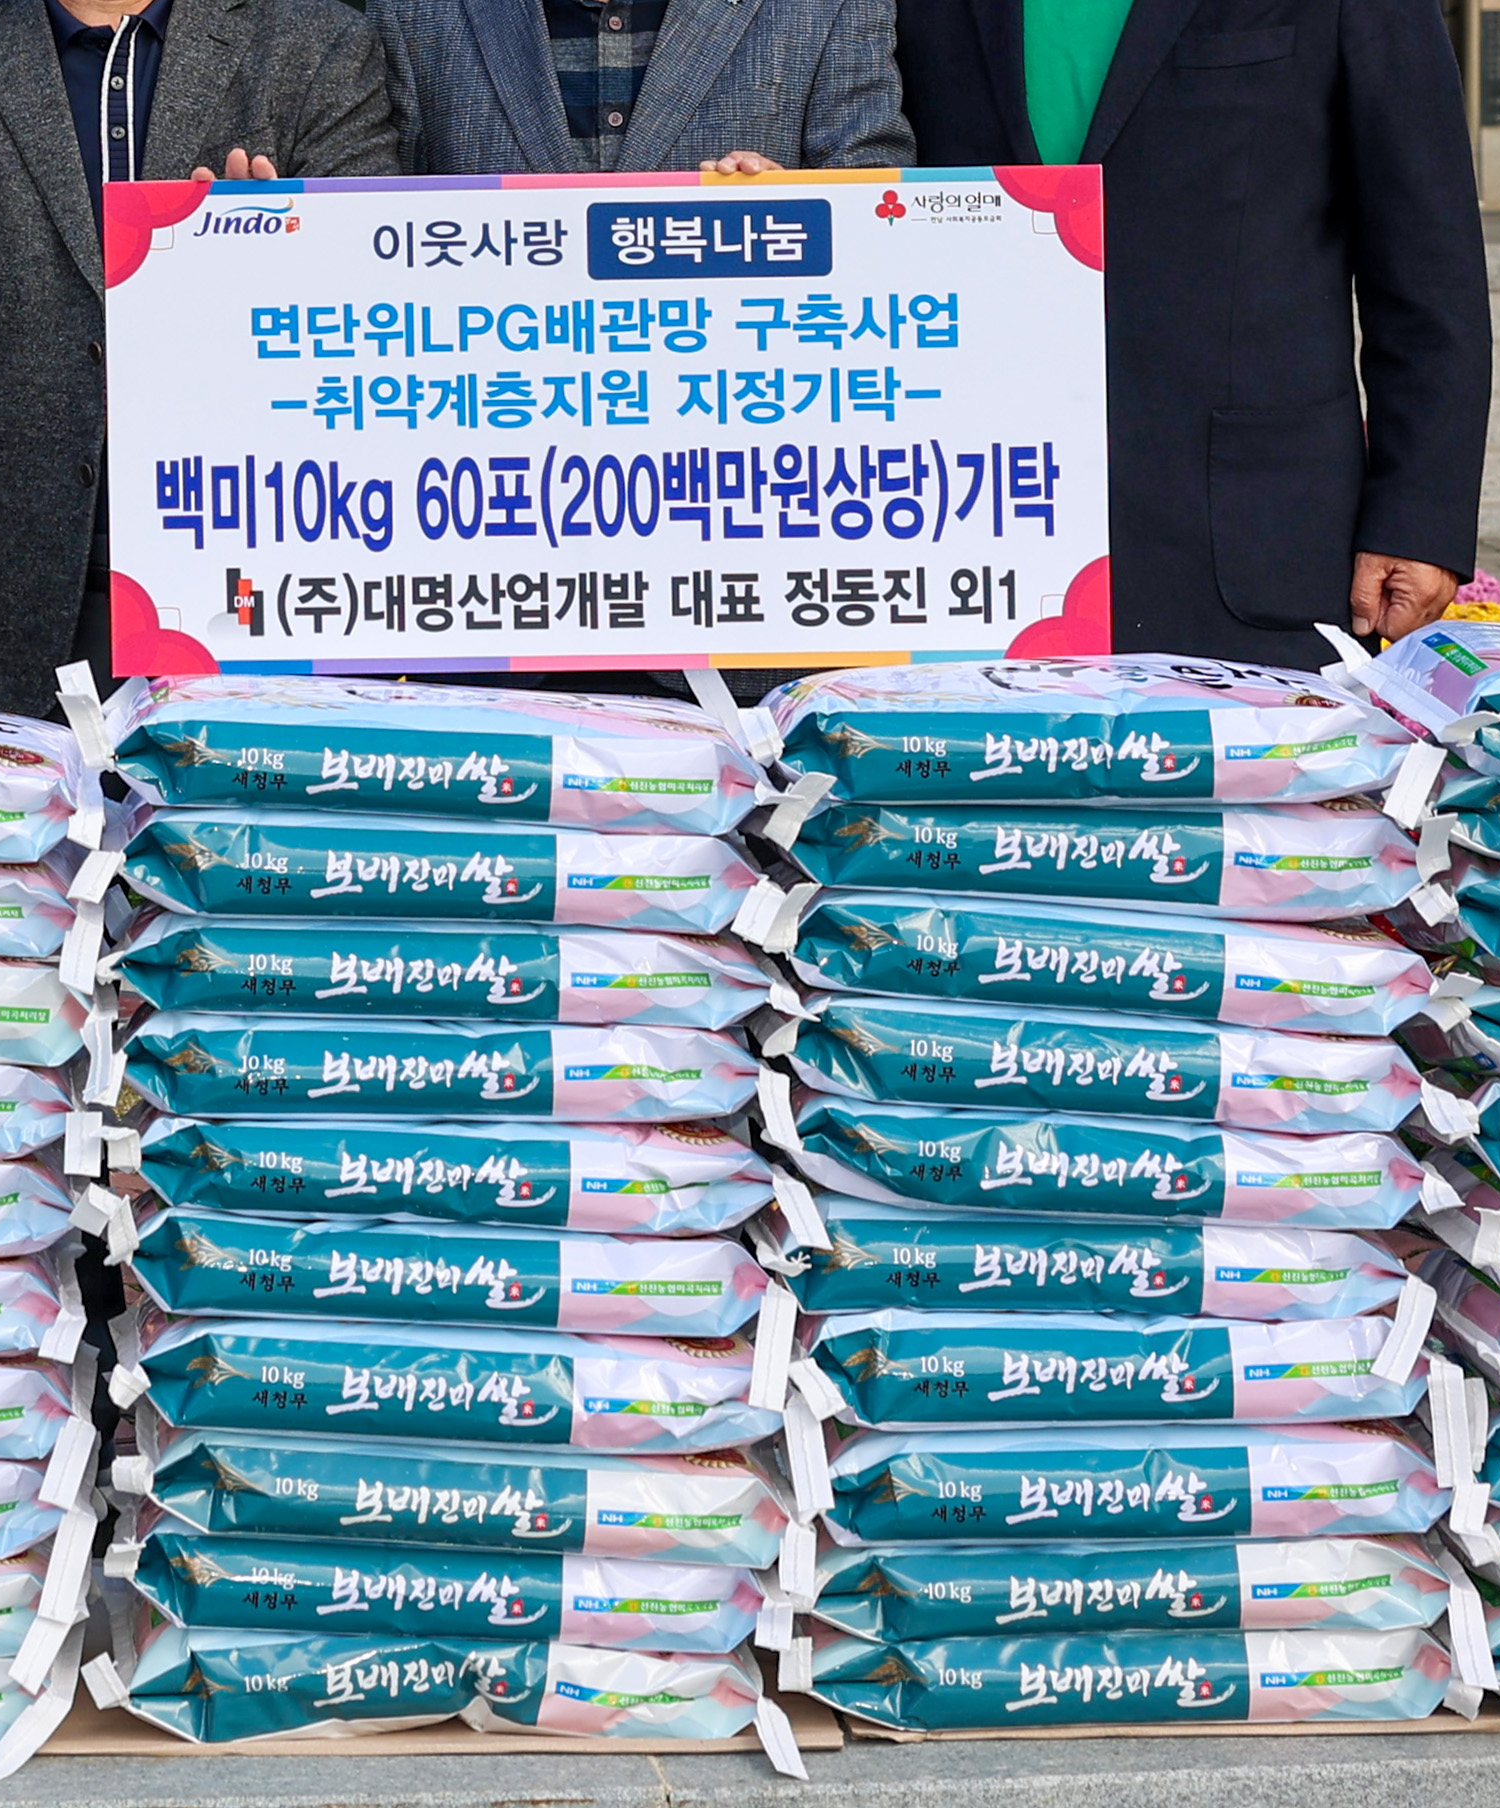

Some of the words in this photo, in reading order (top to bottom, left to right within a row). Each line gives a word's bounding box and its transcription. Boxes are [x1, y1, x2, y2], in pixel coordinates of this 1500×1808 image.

[911, 191, 961, 213] 사랑의
[193, 212, 282, 237] Jindo
[374, 219, 568, 267] 이웃사랑
[611, 215, 807, 265] 행복나눔
[251, 297, 712, 359] 면단위LPG배관망
[736, 293, 958, 351] 구축사업
[156, 455, 393, 552] 백미10kg
[417, 440, 1060, 548] 60포(200백만원상당)기탁
[233, 594, 256, 608] DM
[277, 571, 649, 636] (주)대명산업개발
[671, 570, 764, 628] 대표
[785, 567, 927, 627] 정동진
[949, 566, 1015, 624] 외1
[237, 875, 292, 895] 새청무
[886, 1269, 940, 1288] 새청무
